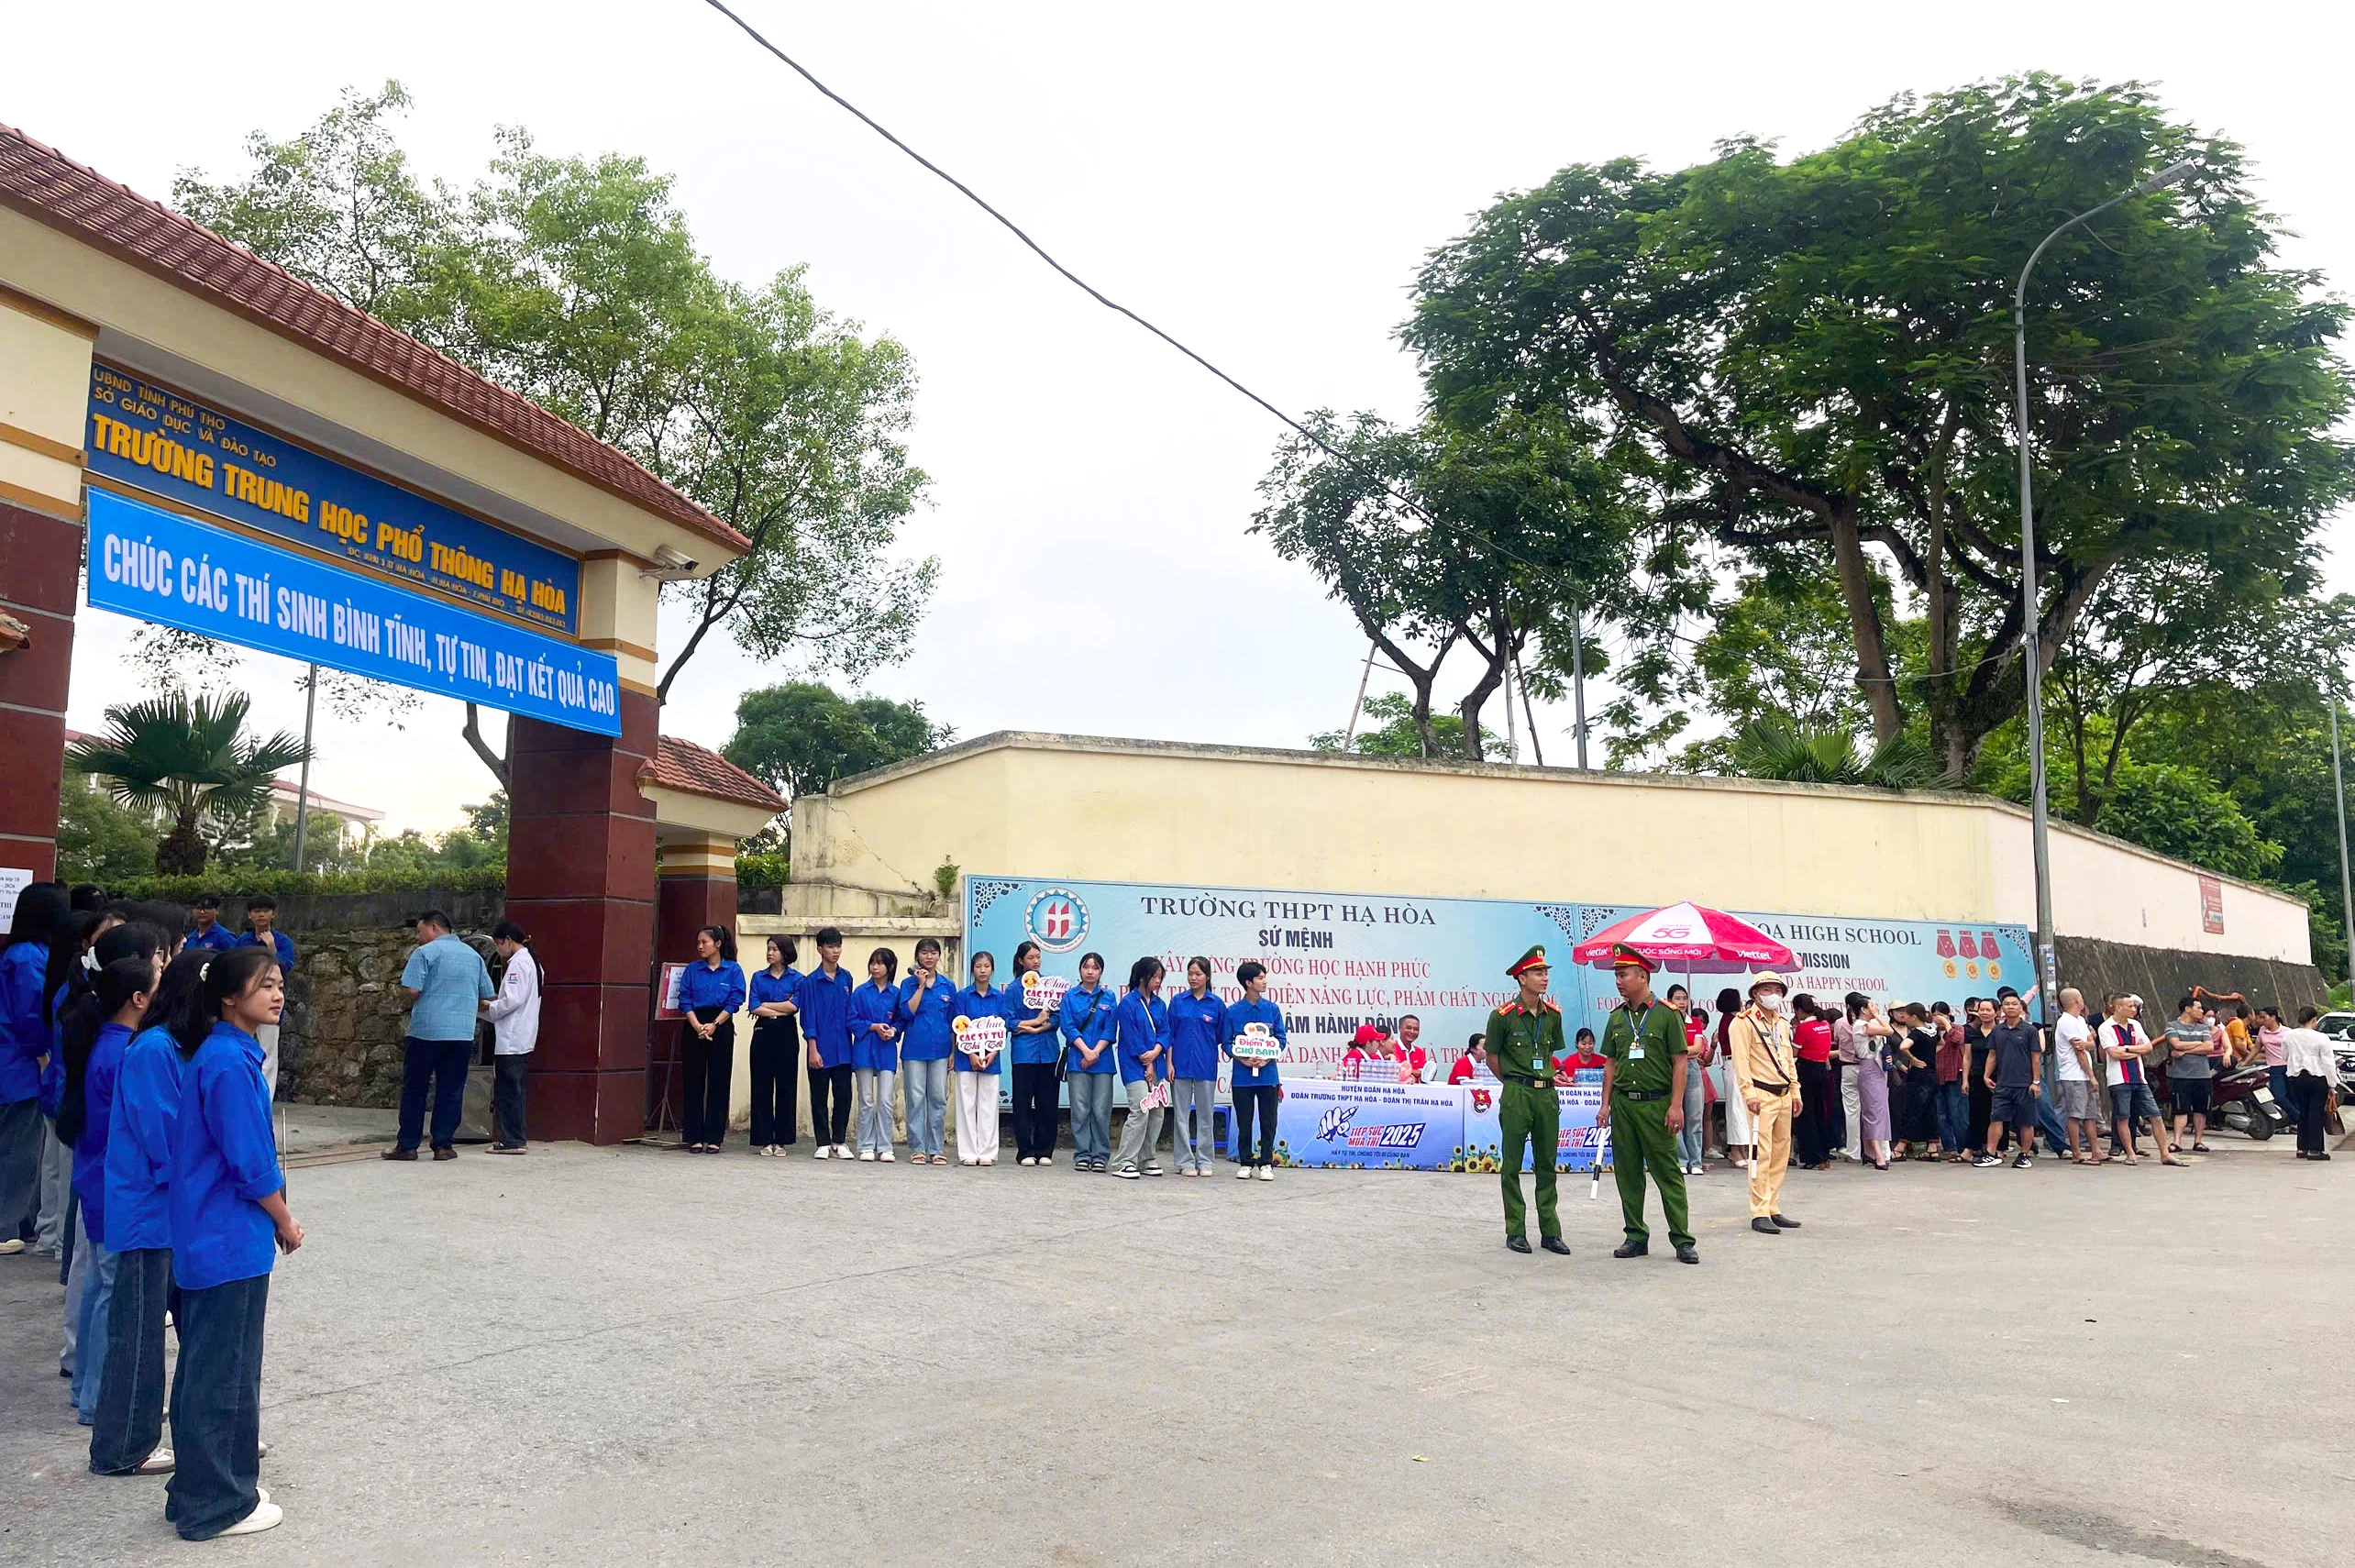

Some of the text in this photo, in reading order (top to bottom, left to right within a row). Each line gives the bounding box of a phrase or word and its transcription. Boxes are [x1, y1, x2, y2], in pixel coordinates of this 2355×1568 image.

[94, 368, 132, 392] UBND
[171, 400, 195, 418] PHÚ
[94, 386, 277, 468] SỞ GIÁO DỤC VÀ ĐÀO TẠO
[93, 414, 566, 616] TRƯỜNG TRUNG HỌC PHỔ THÔNG HẠ HÒA
[105, 534, 615, 716] CHÚC CÁC THÍ SINH BÌNH TĨNH, TỰ TIN, ĐẠT KẾT QUẢ CAO
[1141, 892, 1436, 927] TRƯỜNG THPT HẠ HÒA
[1259, 925, 1333, 952] SỨ MỆNH
[1652, 928, 1690, 939] 5G
[1752, 922, 1922, 945] OA HIGH SCHOOL
[1309, 959, 1340, 979] HỌC
[1343, 959, 1388, 980] HẠNH
[1391, 957, 1432, 978] PHÚC
[1799, 952, 1851, 969] MISSION
[1268, 983, 1305, 1008] DIỆN
[1310, 985, 1352, 1005] NĂNG
[1357, 988, 1390, 1010] LỰC,
[1395, 981, 1436, 1008] PHẨM
[1440, 984, 1477, 1008] CHẤT
[1807, 977, 1841, 990] HAPPY
[1844, 977, 1888, 991] SCHOOL
[1316, 1012, 1360, 1033] HÀNH
[1266, 1040, 1276, 1048] 10
[1299, 1046, 1341, 1064] DANH
[1366, 1137, 1379, 1146] THI
[1380, 1124, 1423, 1146] 2025
